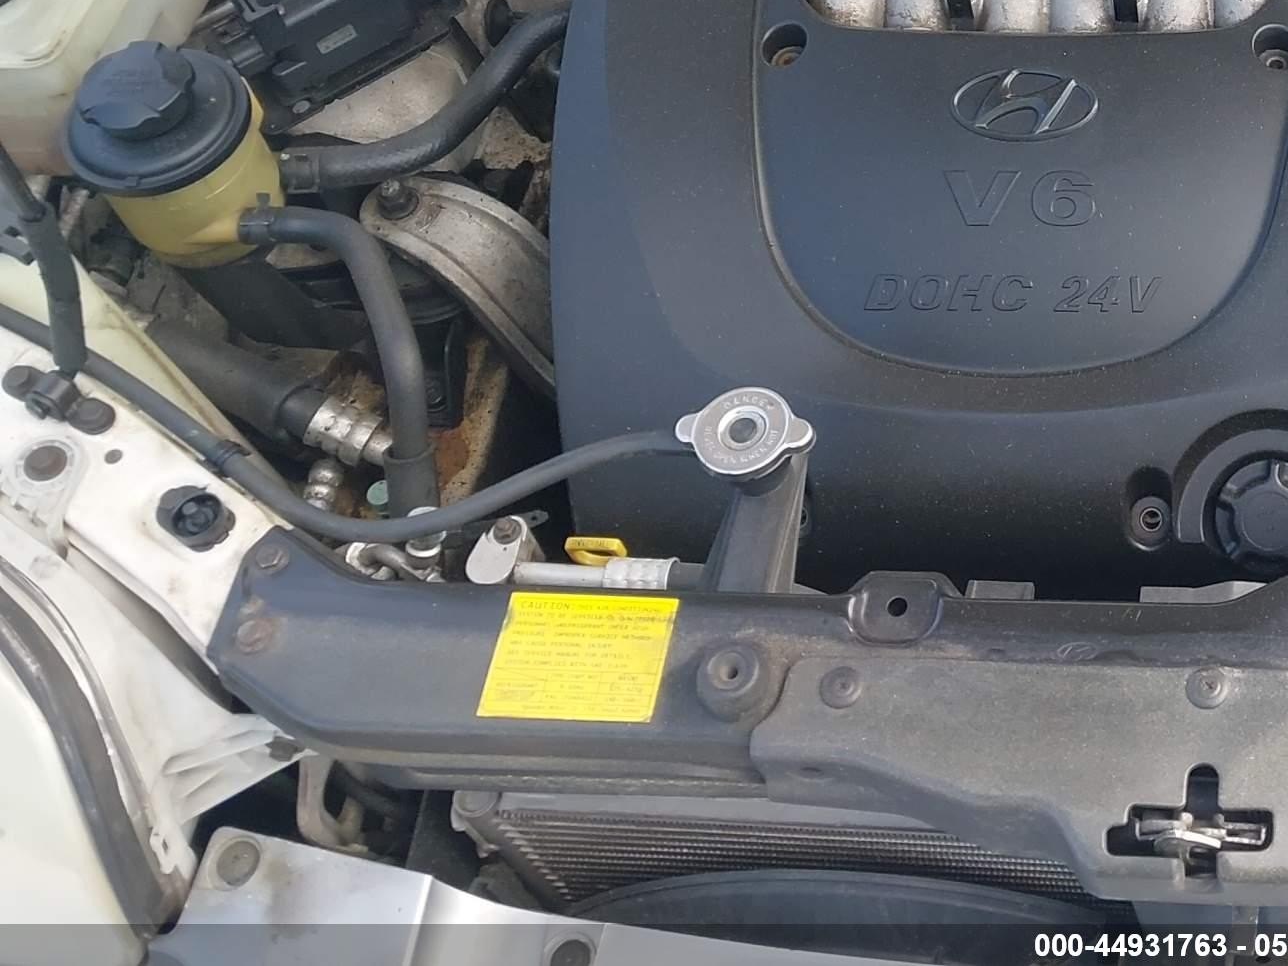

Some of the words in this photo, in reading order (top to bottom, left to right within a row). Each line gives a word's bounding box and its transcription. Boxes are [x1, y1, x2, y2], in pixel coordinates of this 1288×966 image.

[943, 169, 1096, 227] V6
[863, 273, 1033, 312] DOHC
[1052, 274, 1163, 313] 24V
